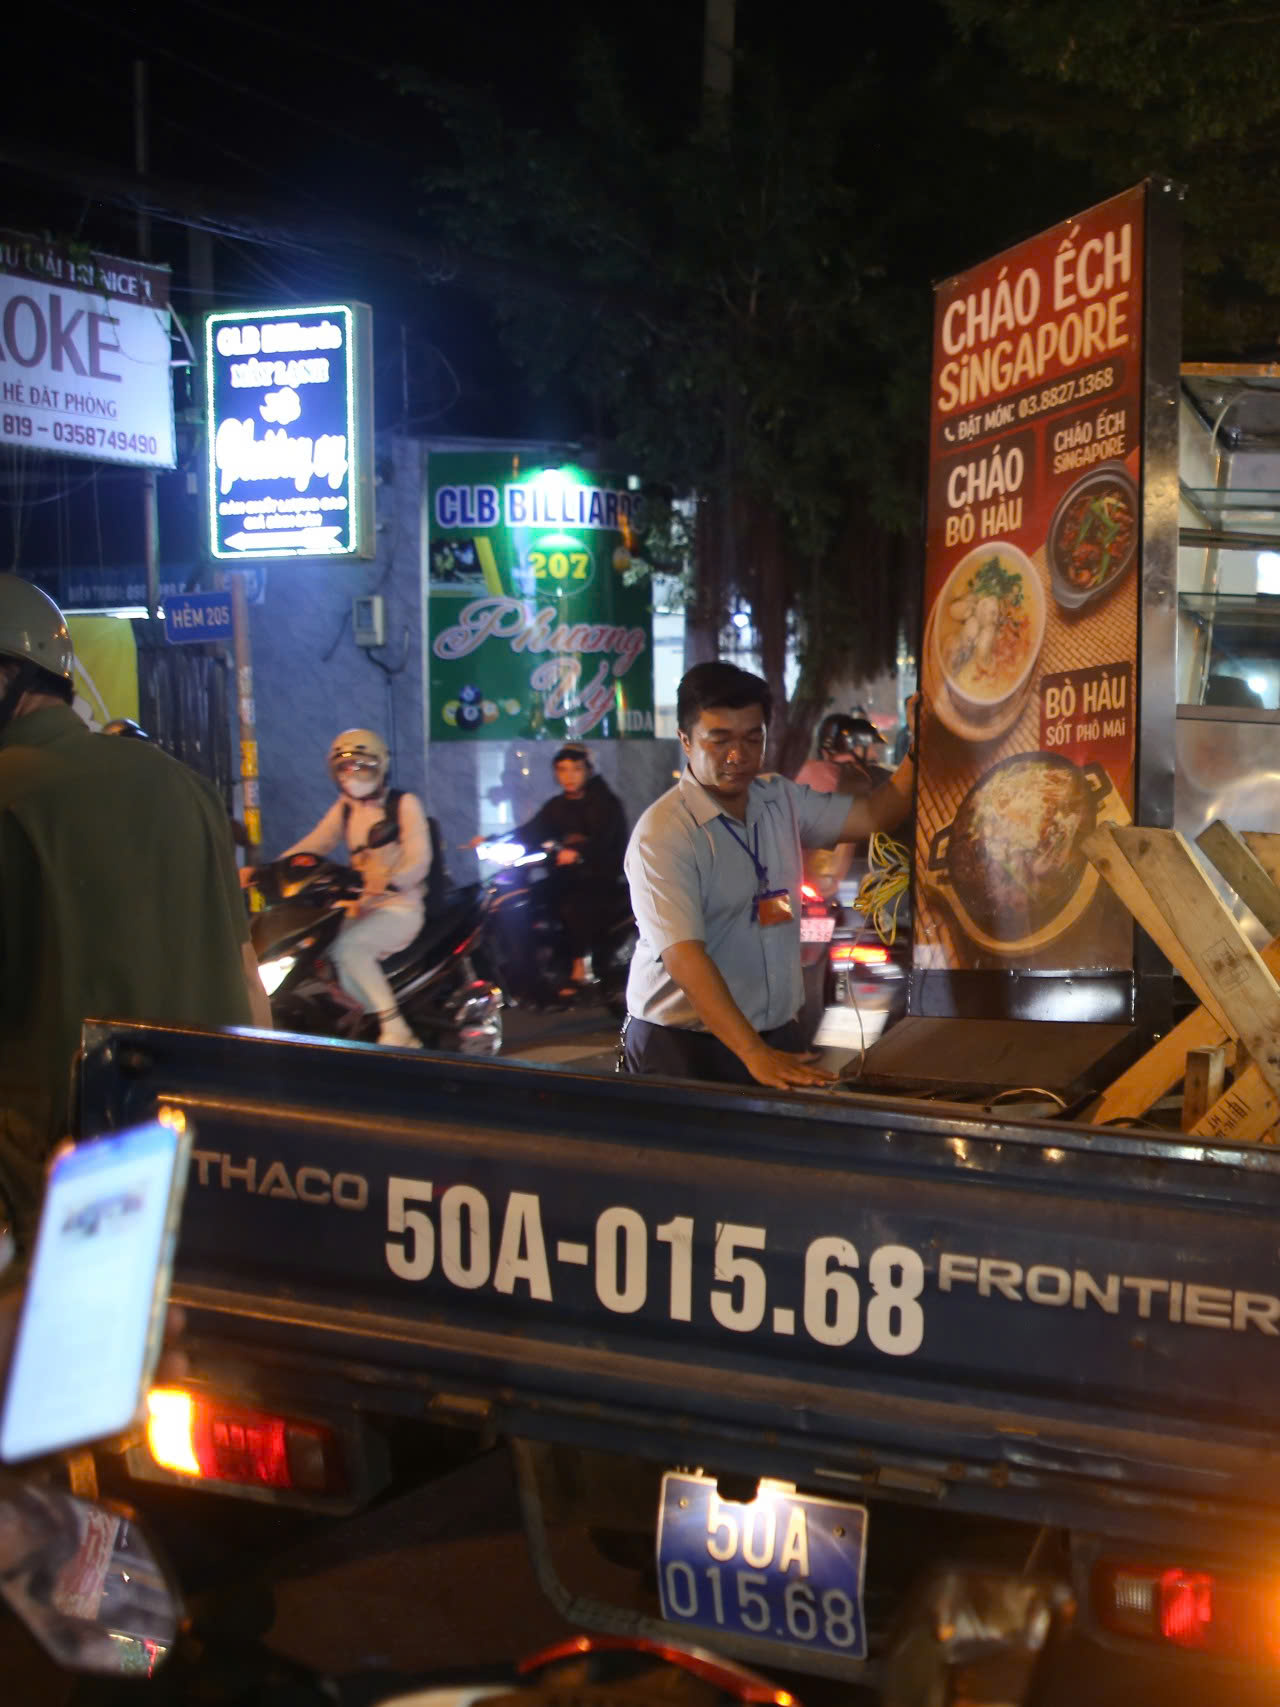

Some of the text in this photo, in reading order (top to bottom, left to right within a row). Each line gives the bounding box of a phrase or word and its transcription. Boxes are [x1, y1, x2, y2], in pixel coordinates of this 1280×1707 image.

[100, 269, 138, 296] NICE
[942, 224, 1132, 356] CHÁO ẾCH
[0, 294, 122, 382] OKE
[65, 392, 117, 418] PHÒNG
[1018, 367, 1114, 418] 03.8827.1368
[1054, 408, 1126, 453] CHÁO ẾCH
[948, 444, 1024, 509] CHÁO
[437, 486, 498, 526] CLB
[944, 495, 1023, 548] BÒ HÀU
[528, 553, 590, 579] 207
[206, 606, 230, 625] 205
[434, 596, 646, 676] Phương
[1045, 671, 1127, 719] BÒ HÀU
[1046, 720, 1071, 746] SỐT
[191, 1150, 369, 1211] THACO
[385, 1176, 925, 1357] 50A-015.68
[706, 1492, 810, 1577] 50A
[665, 1560, 857, 1648] 015.68
